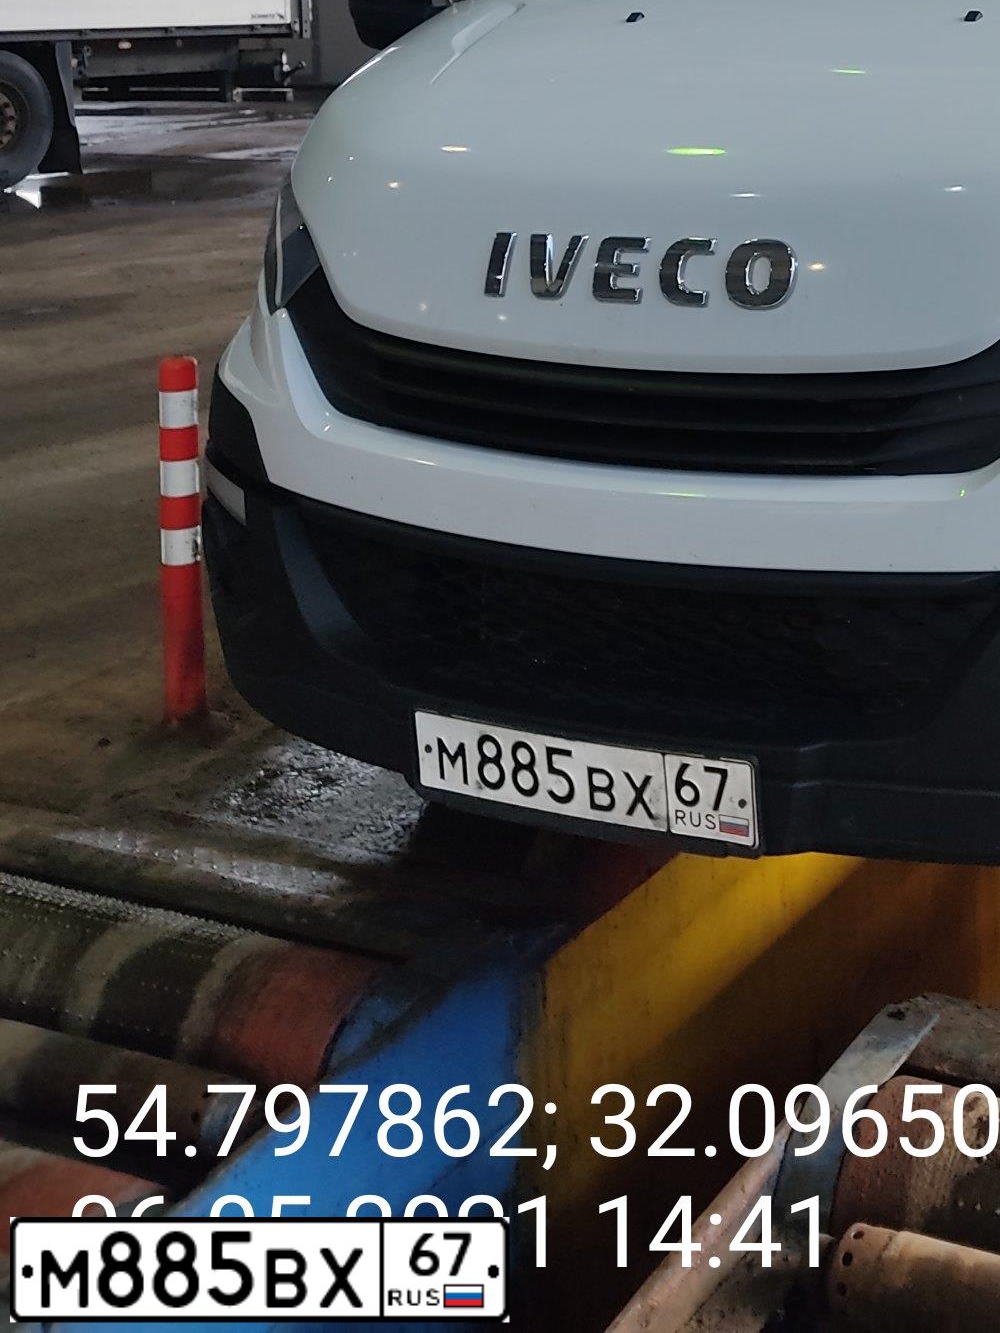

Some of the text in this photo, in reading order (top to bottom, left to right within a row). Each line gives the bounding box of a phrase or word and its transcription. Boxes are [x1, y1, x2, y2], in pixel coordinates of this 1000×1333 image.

[484, 232, 798, 310] IVECO
[674, 763, 729, 812] 67
[674, 809, 718, 831] RUS
